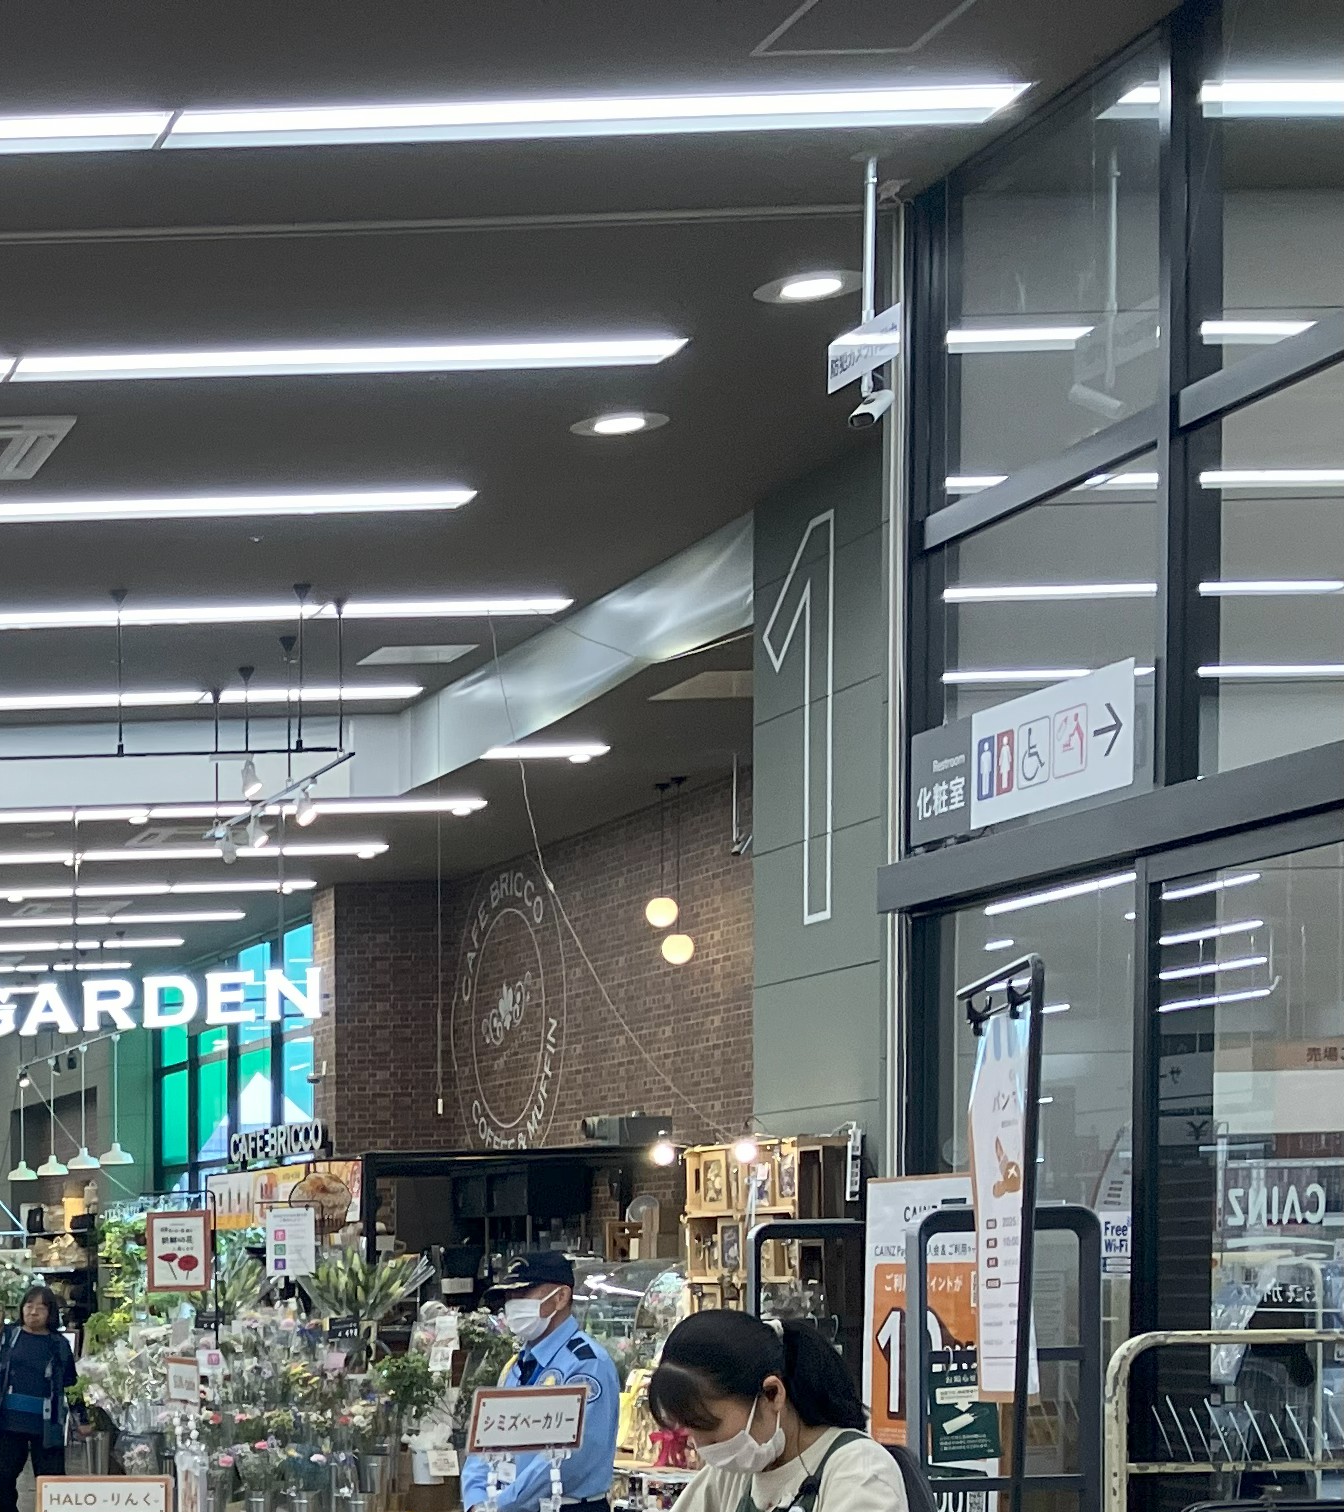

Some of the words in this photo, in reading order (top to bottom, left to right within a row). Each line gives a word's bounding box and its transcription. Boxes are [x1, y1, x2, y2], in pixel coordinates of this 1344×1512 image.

[932, 753, 966, 773] Restroom
[916, 776, 966, 821] 化粧室
[490, 870, 543, 923] BRICCO
[463, 902, 489, 1001] CAFE
[528, 1016, 559, 1141] MUFFIN
[230, 1130, 263, 1162] CAFE
[269, 1118, 322, 1156] BRICCO
[1104, 1221, 1128, 1237] Free
[1104, 1238, 1128, 1253] Wi-Fi
[483, 1409, 574, 1433] シミズベーカリー
[49, 1493, 97, 1506] HALO
